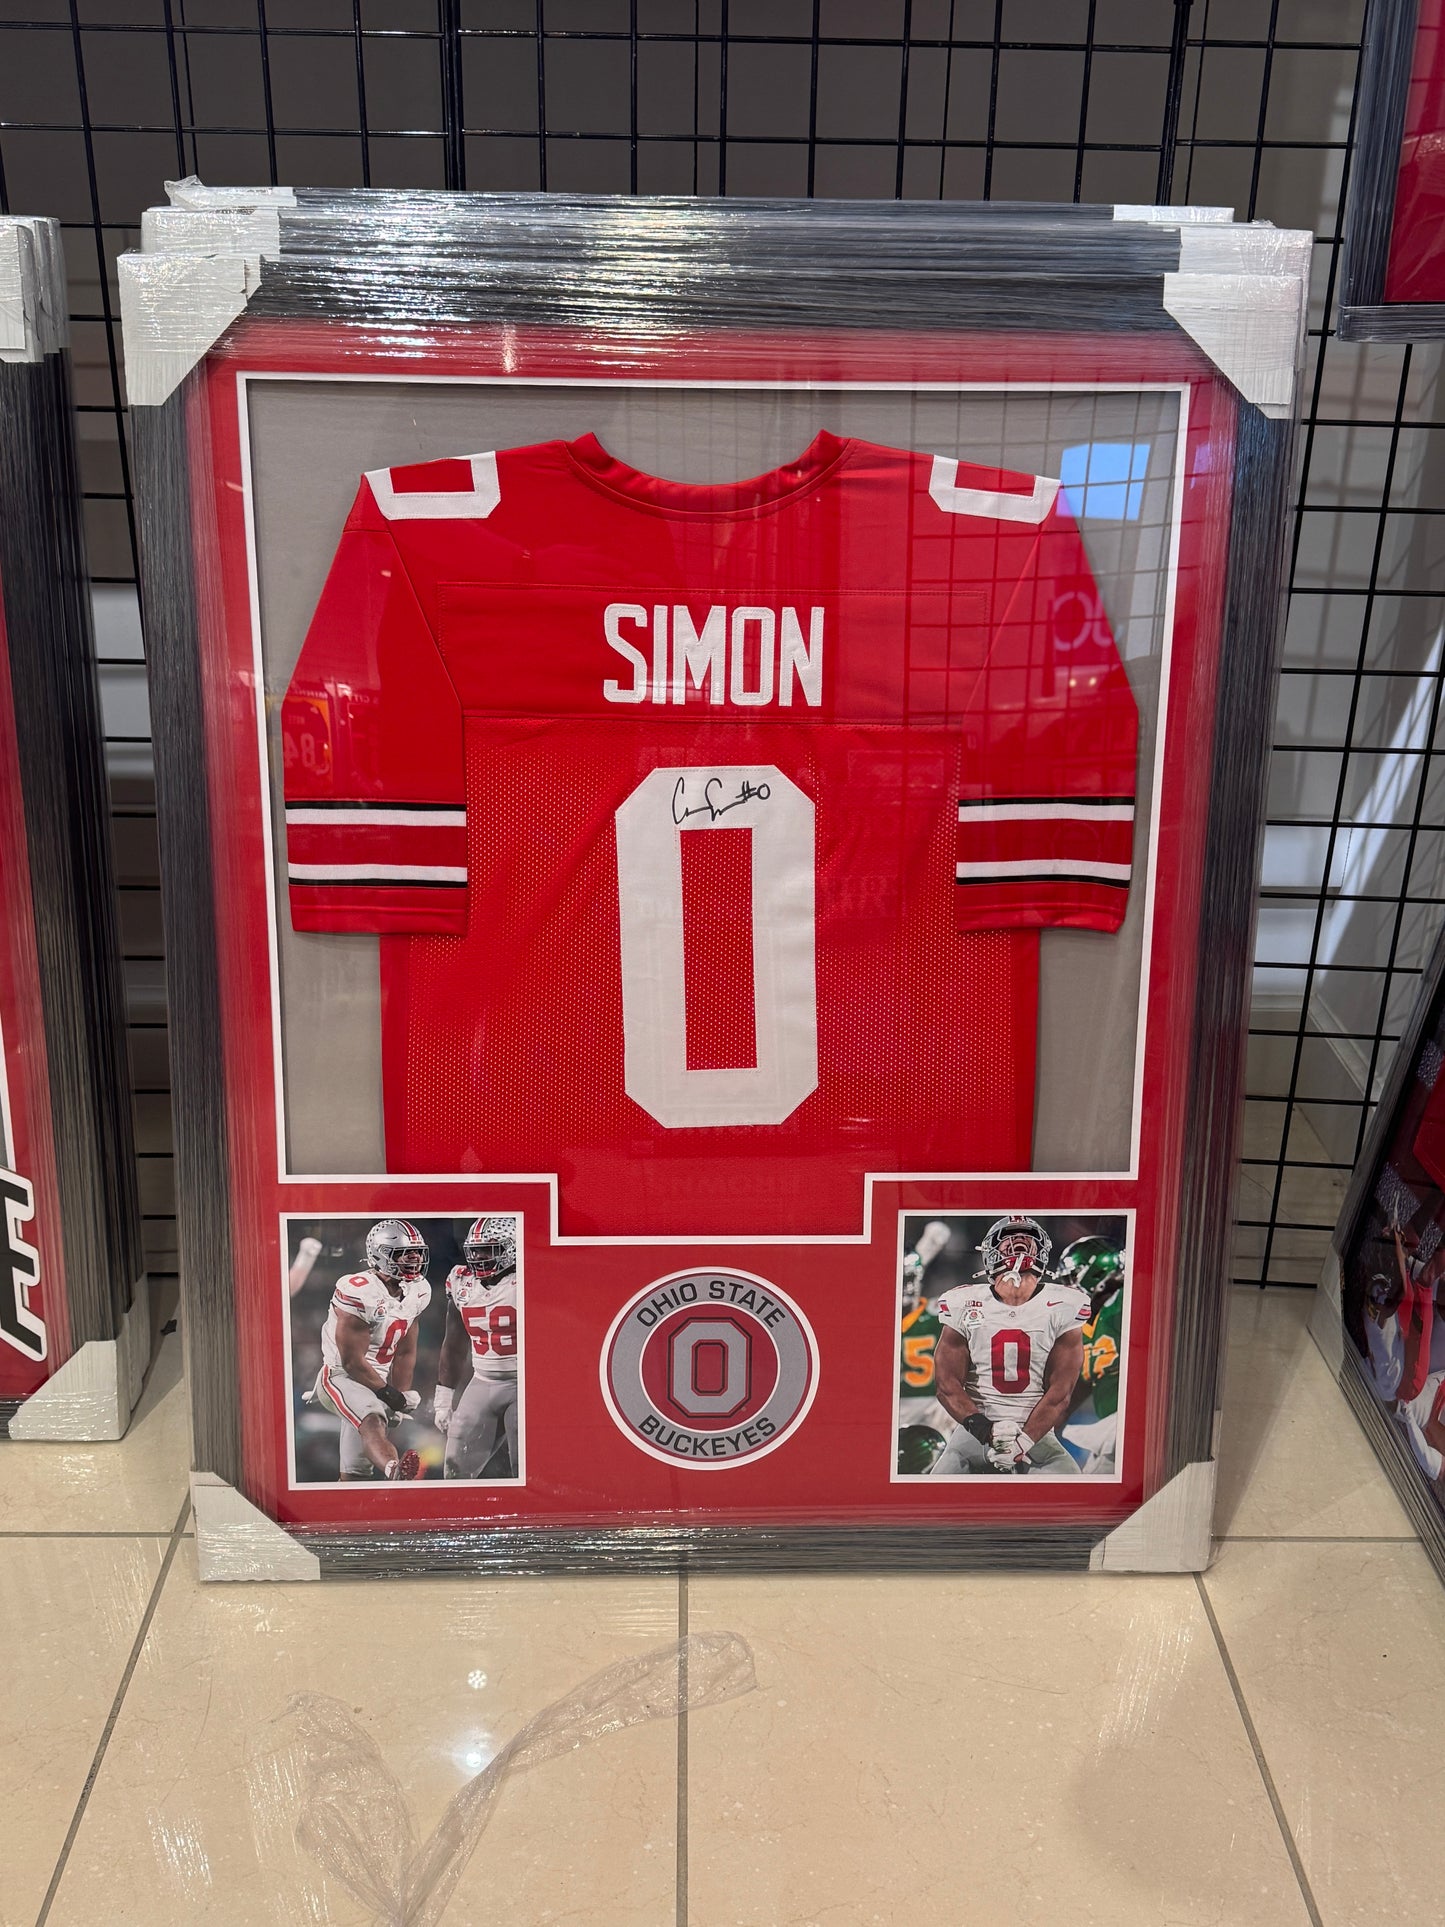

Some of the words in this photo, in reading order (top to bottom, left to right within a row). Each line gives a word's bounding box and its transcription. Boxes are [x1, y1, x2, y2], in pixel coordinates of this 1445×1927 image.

[604, 603, 824, 706] SIMON
[615, 765, 816, 1127] 0
[462, 1306, 517, 1355] 58
[636, 1283, 698, 1327] OHIO
[708, 1280, 786, 1329] STATE
[991, 1330, 1030, 1394] 0
[639, 1415, 776, 1456] BUCKEYES
